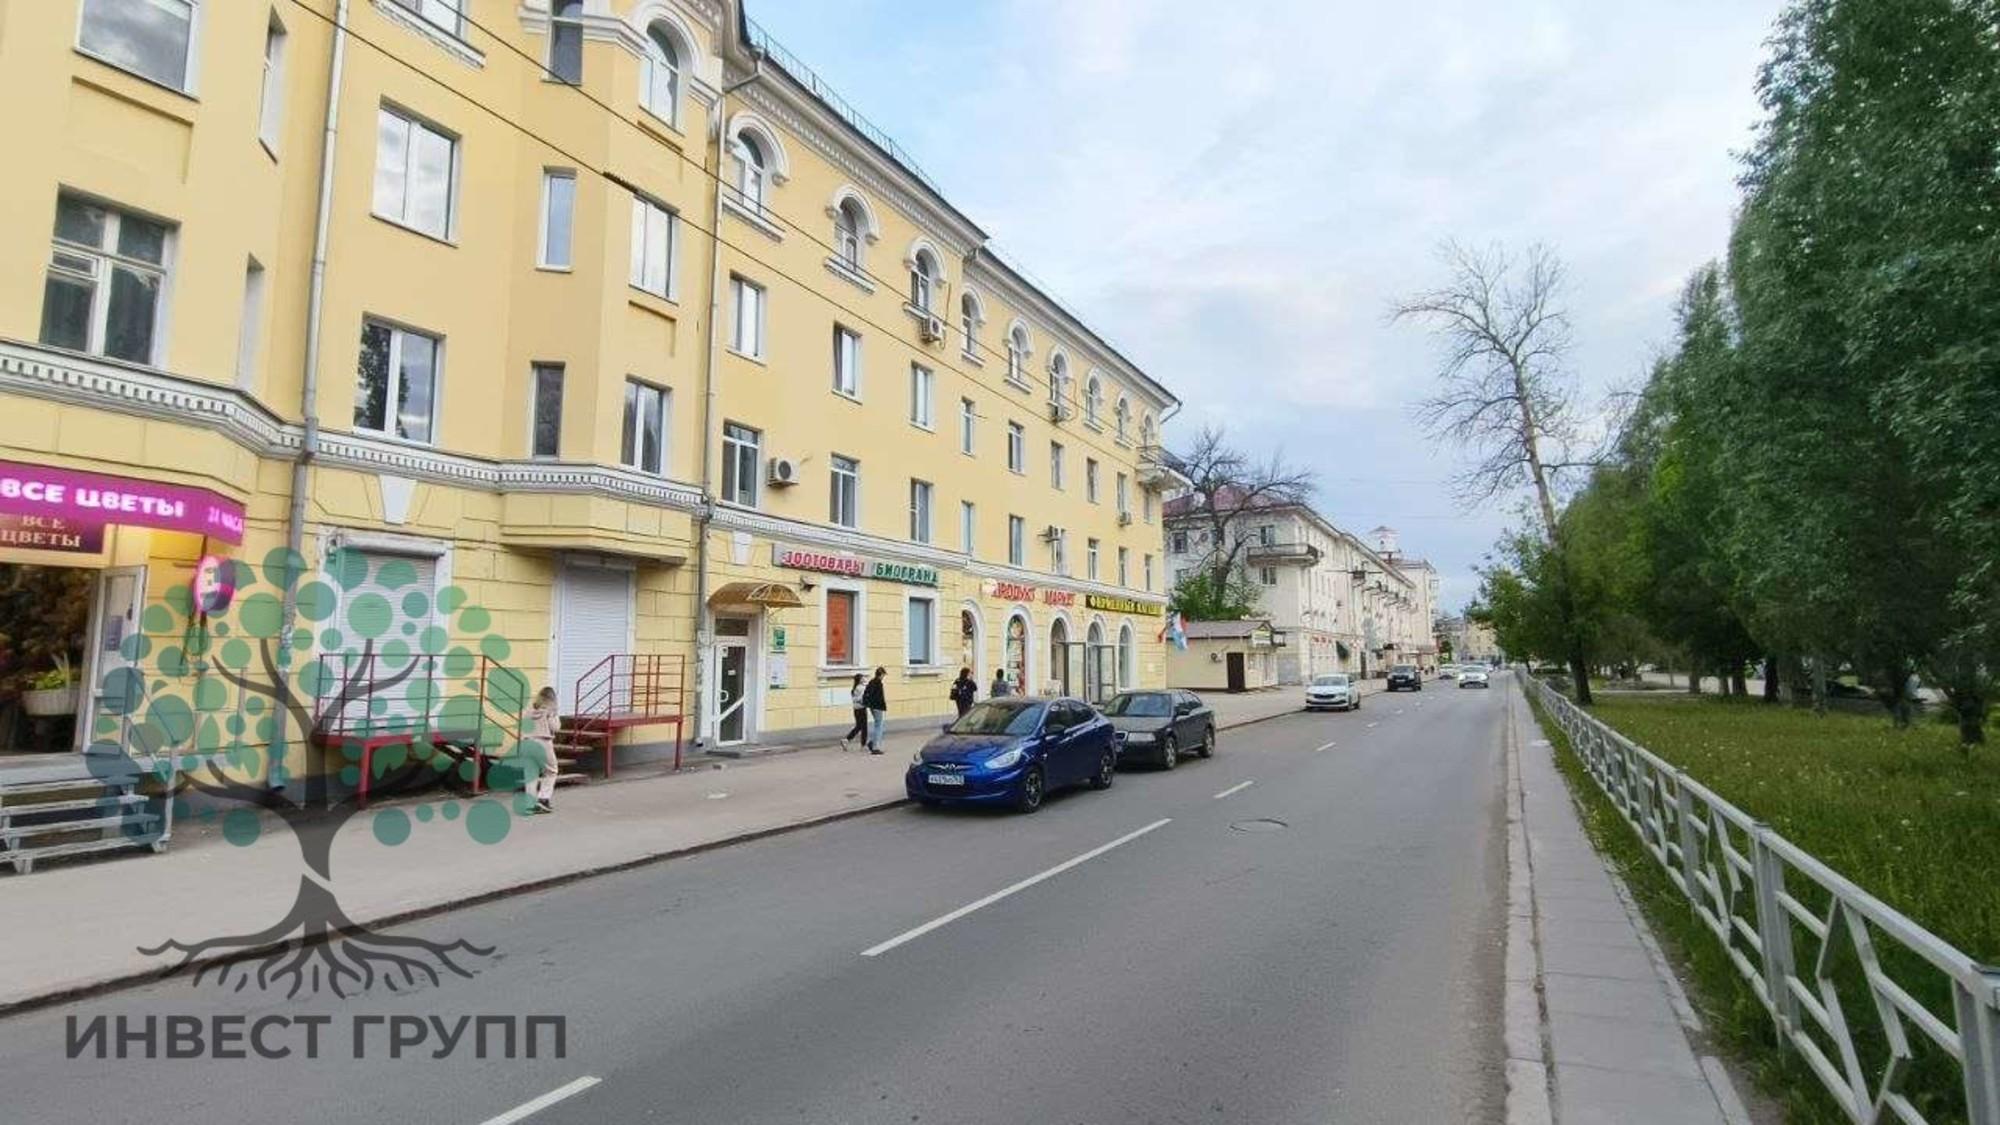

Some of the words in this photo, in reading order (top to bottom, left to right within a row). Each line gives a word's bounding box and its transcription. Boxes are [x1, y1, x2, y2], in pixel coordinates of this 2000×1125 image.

[0, 478, 65, 503] ВСЕ
[75, 488, 184, 517] ЦВЕТЫ
[22, 515, 66, 529] ВСЕ
[1, 529, 81, 548] ЦВЕТЫ
[782, 551, 865, 574] ЗООТОВАРЫ
